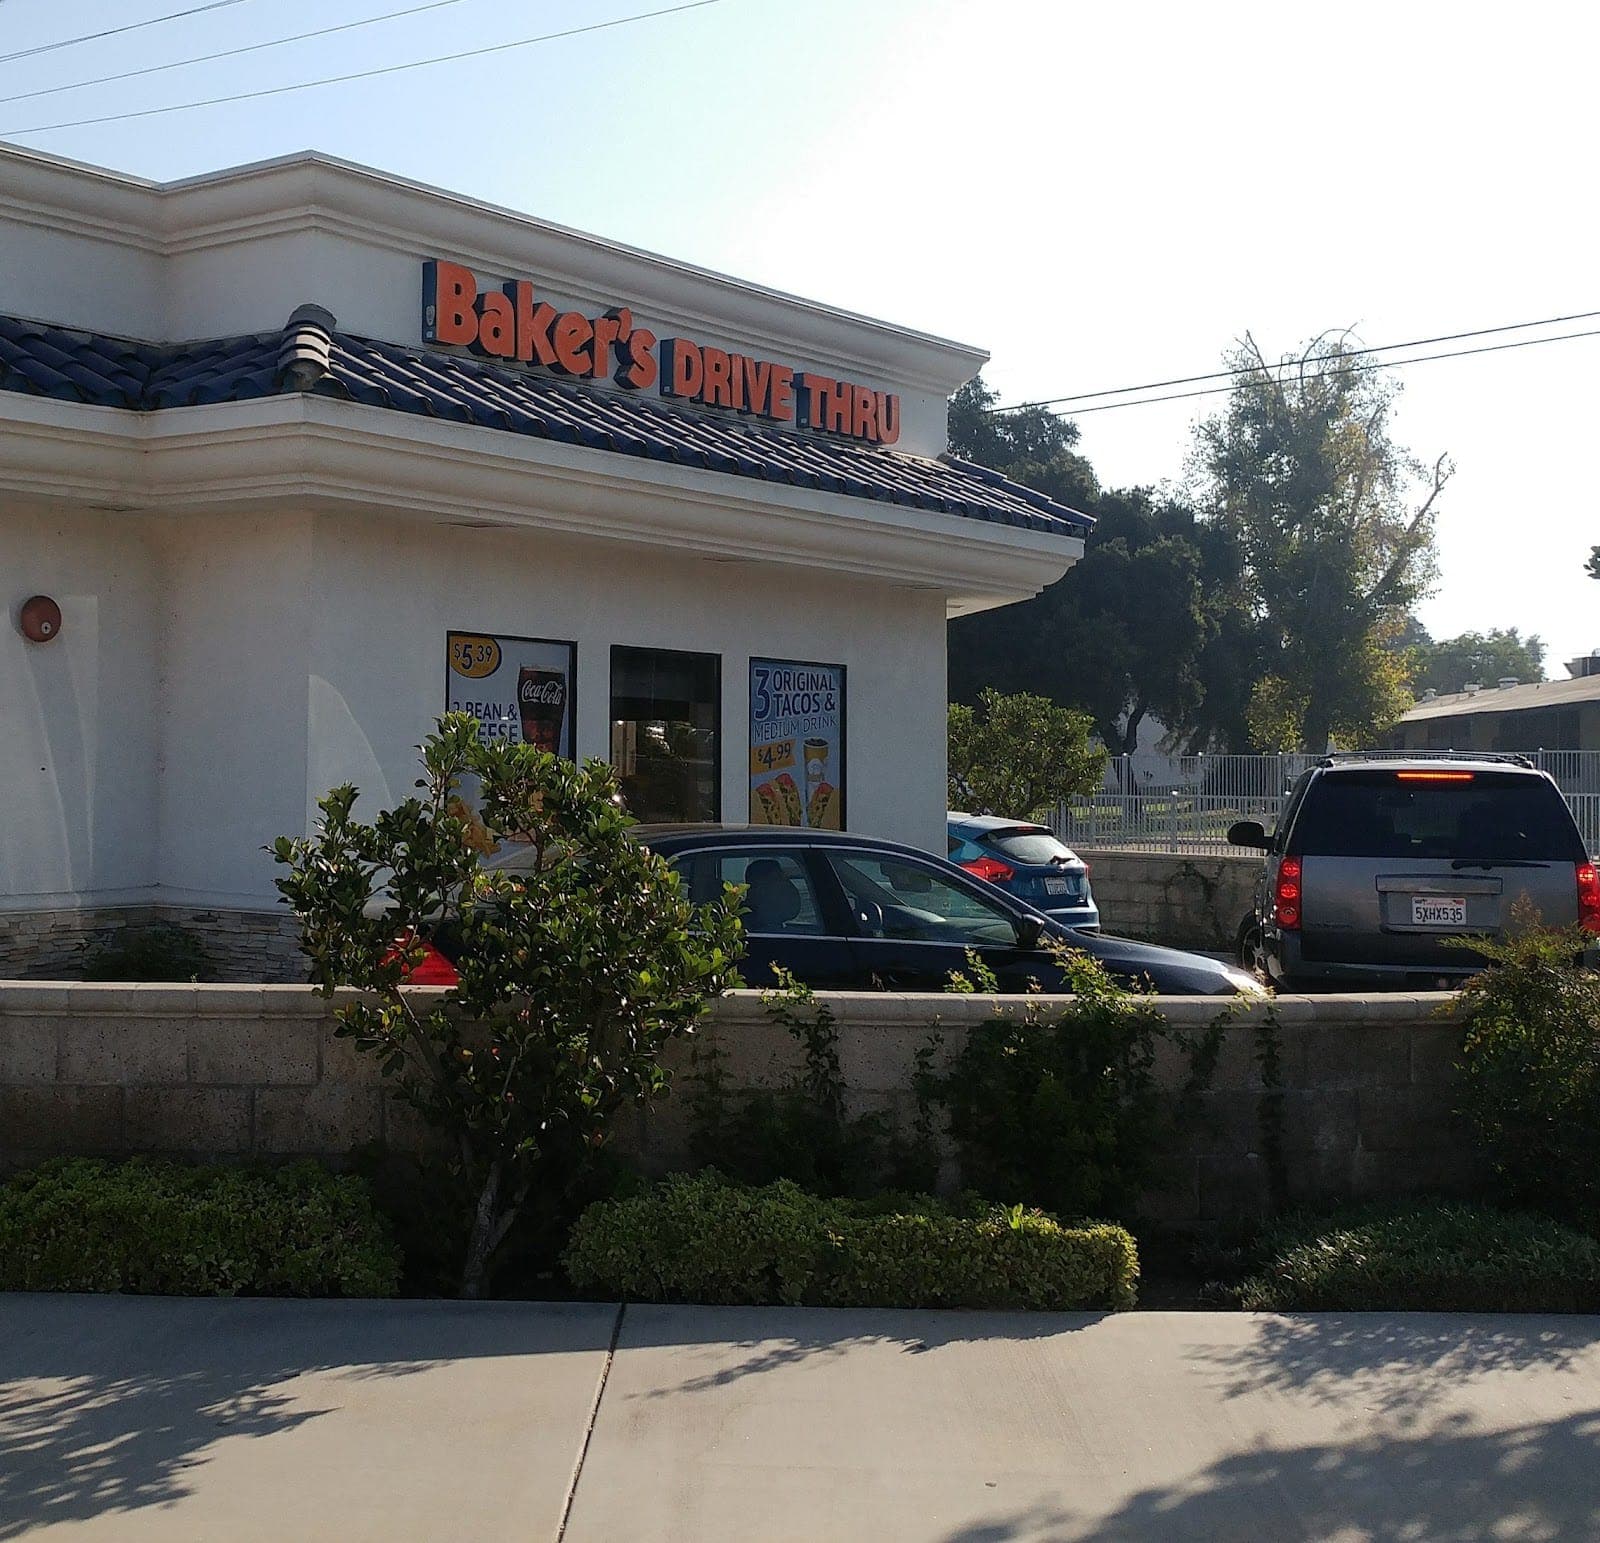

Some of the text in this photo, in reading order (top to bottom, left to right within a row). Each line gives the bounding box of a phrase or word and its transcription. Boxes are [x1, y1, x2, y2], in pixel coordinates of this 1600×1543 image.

[434, 260, 900, 445] Baker's DRIVE THRU
[454, 643, 493, 670] $5.39
[521, 679, 563, 705] Coca-Cola
[754, 669, 771, 719] 3
[773, 670, 836, 692] ORIGINAL
[465, 701, 502, 719] BEAN
[507, 703, 518, 720] &
[773, 692, 836, 717] TACOS &
[754, 716, 837, 742] MEDIUM DRINK
[757, 742, 792, 769] $4.99
[1415, 906, 1463, 921] 5XHX535
